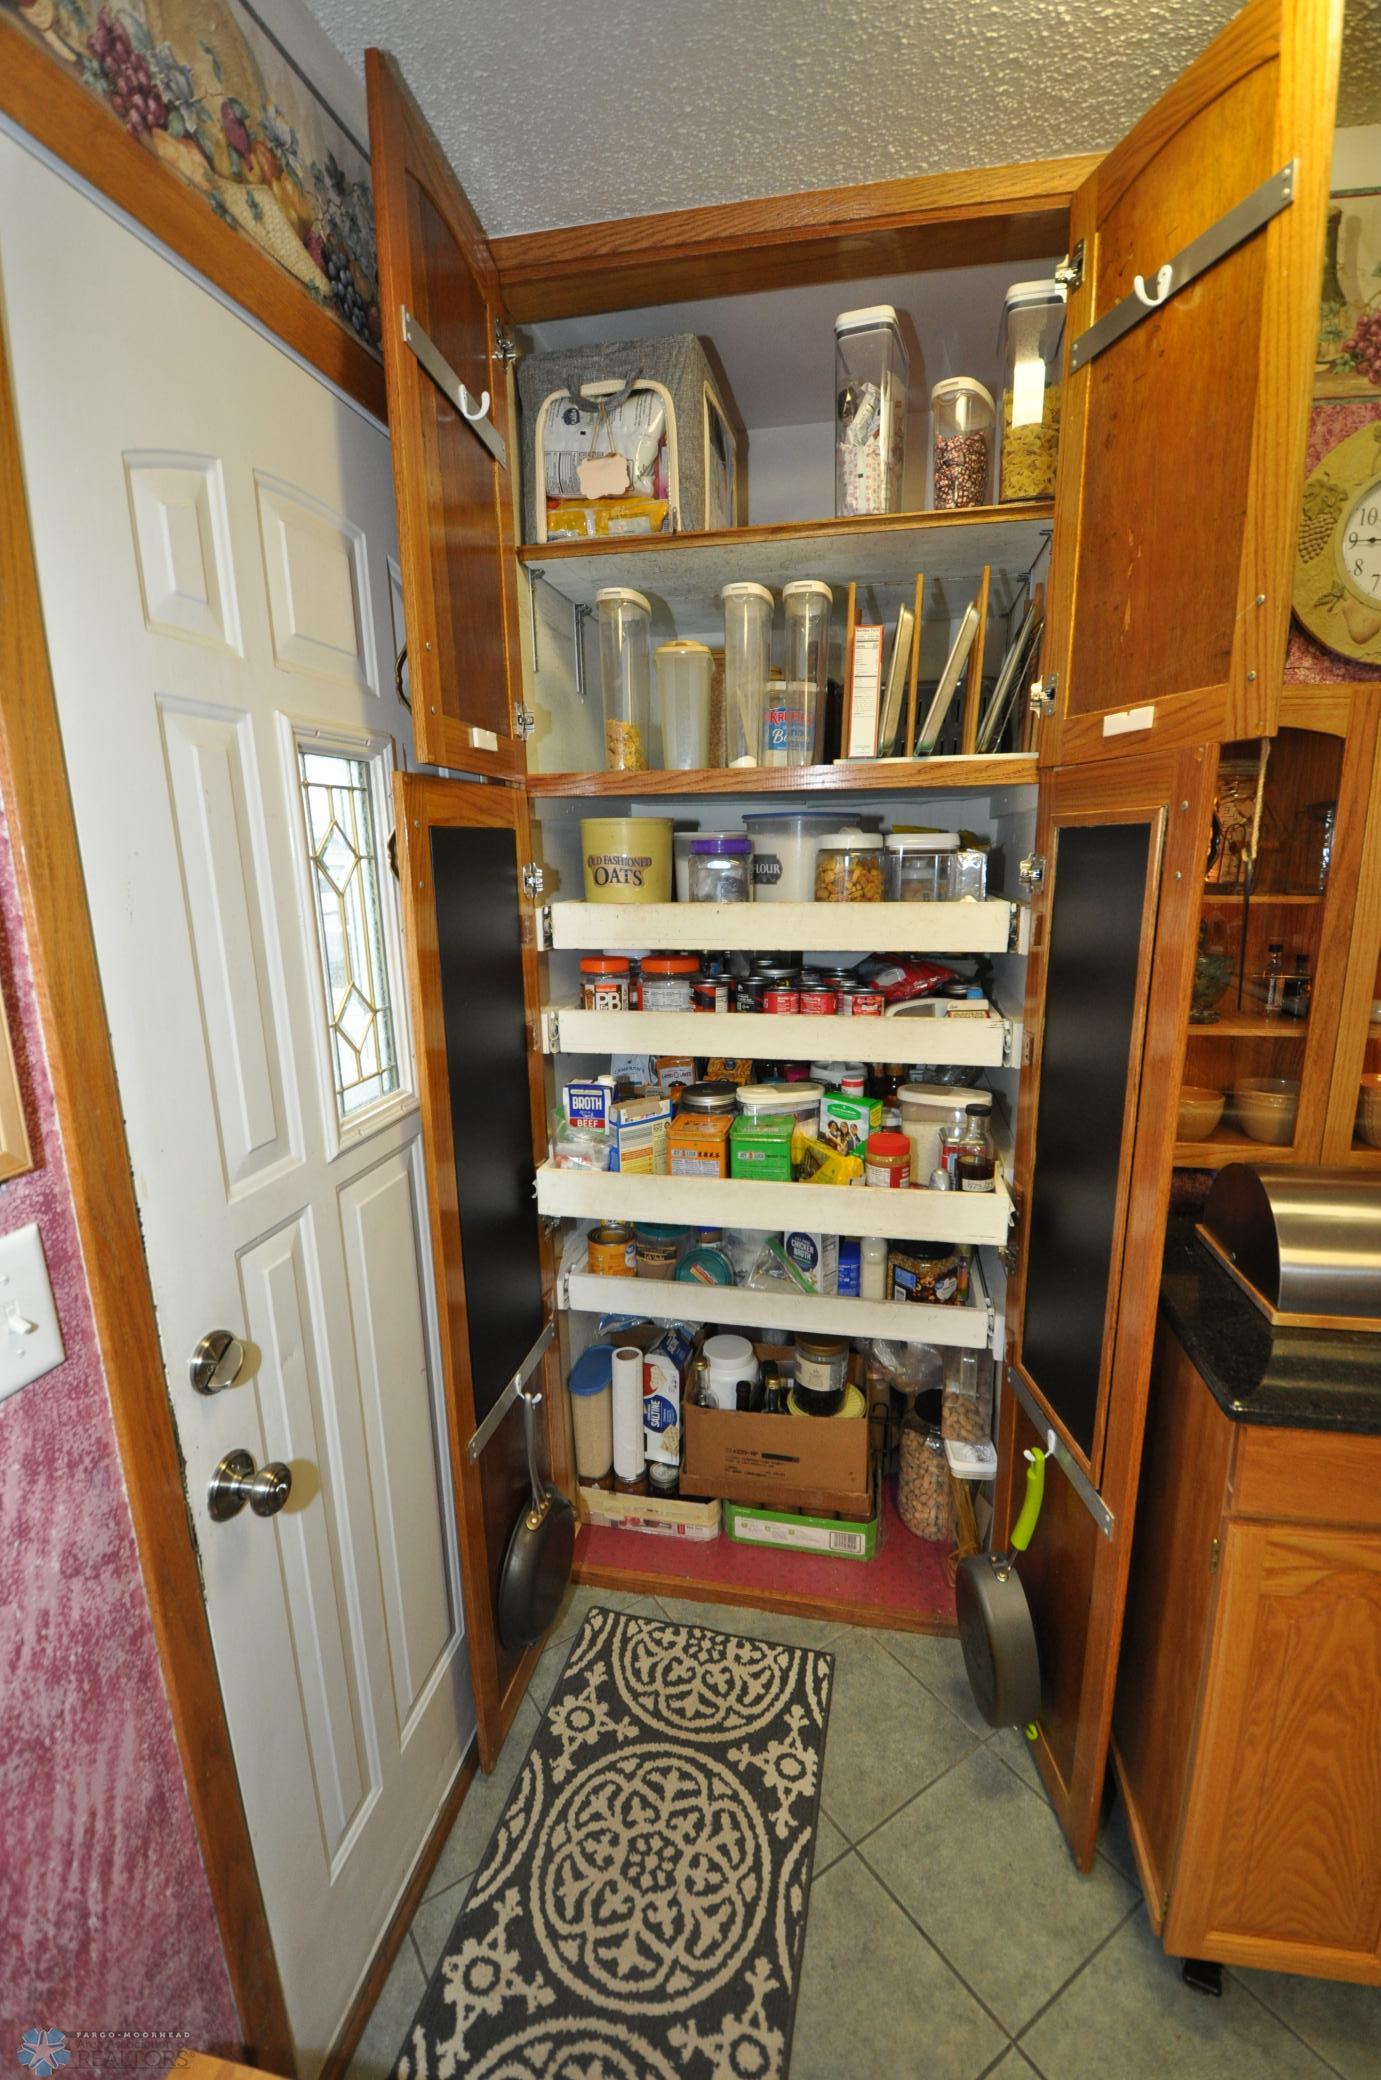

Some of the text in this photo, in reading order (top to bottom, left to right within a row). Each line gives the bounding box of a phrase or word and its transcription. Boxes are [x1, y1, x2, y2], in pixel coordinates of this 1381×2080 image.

[1360, 507, 1378, 526] 10
[1348, 531, 1358, 550] 9
[1353, 558, 1364, 576] 8
[1370, 573, 1381, 592] 7
[588, 855, 653, 868] OLD FASHIONED
[753, 863, 781, 874] LOUR
[594, 866, 643, 887] OATS
[595, 991, 622, 1011] PB
[572, 1096, 602, 1110] BROTH
[577, 1119, 599, 1128] BEEF
[791, 1238, 814, 1255] CHICKEN
[793, 1247, 812, 1261] BROTH
[650, 1399, 660, 1428] SALTINE
